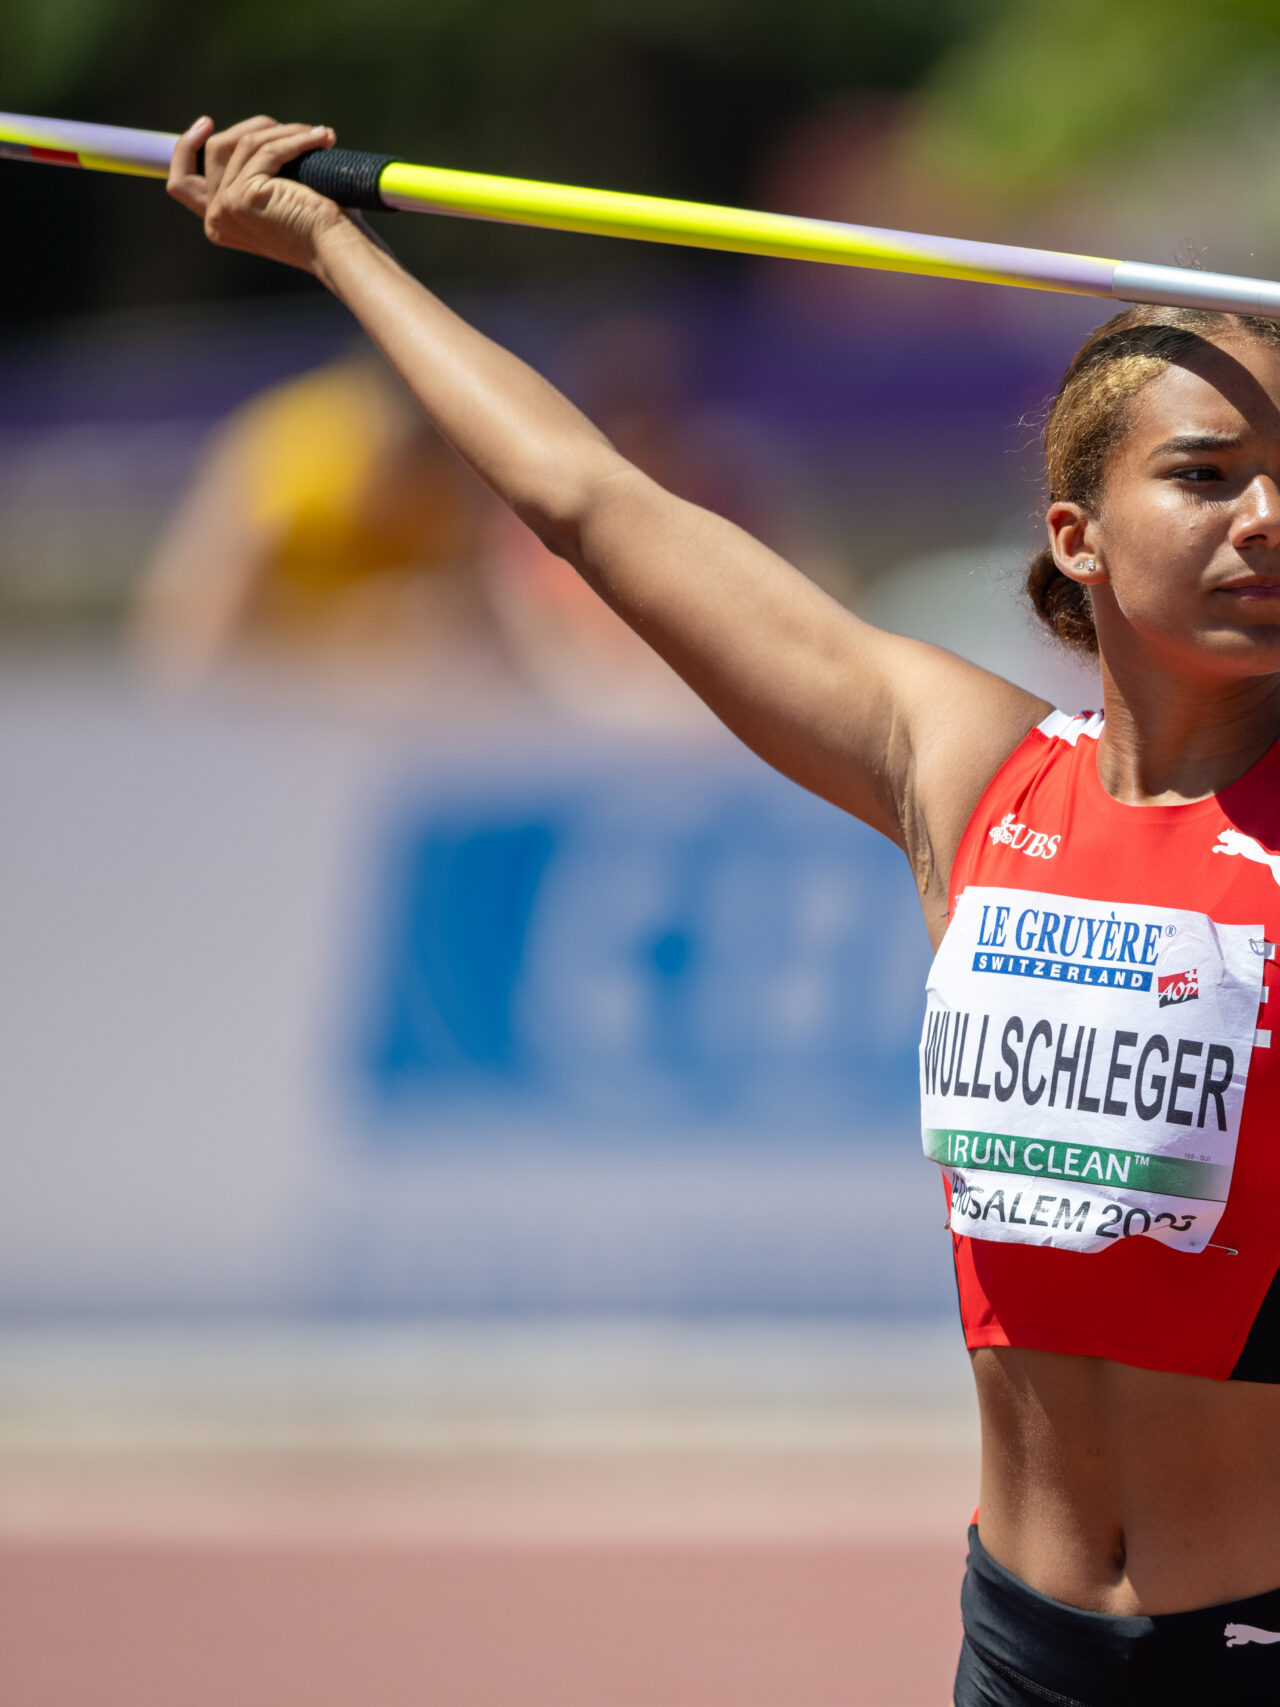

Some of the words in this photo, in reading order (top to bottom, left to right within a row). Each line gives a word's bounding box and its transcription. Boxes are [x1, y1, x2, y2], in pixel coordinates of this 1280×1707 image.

[1011, 824, 1061, 859] UBS
[977, 905, 1011, 947] LE
[978, 955, 1143, 988] SWITZERLAND
[1160, 981, 1198, 1002] AOP
[924, 1011, 1235, 1132] WULLSCHLEGER
[948, 1134, 952, 1161] I
[954, 1134, 1016, 1168] RUN
